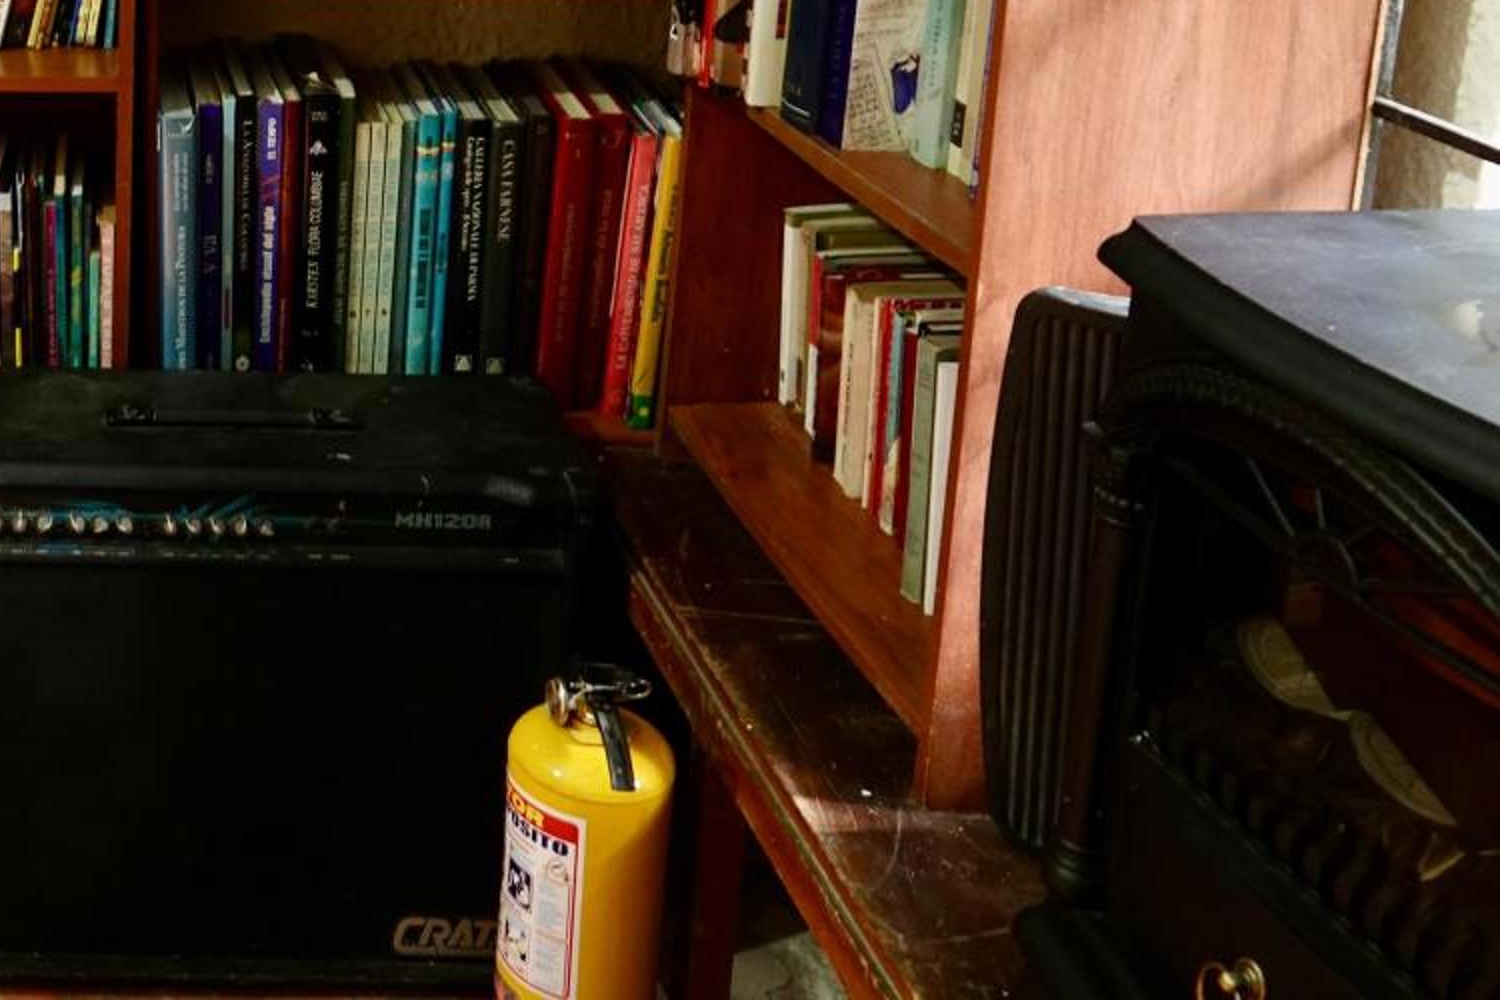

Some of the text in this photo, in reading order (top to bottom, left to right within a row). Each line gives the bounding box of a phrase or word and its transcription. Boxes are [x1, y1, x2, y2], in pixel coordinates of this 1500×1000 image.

[497, 139, 517, 241] CASA FARNESE
[508, 811, 569, 857] OSITO
